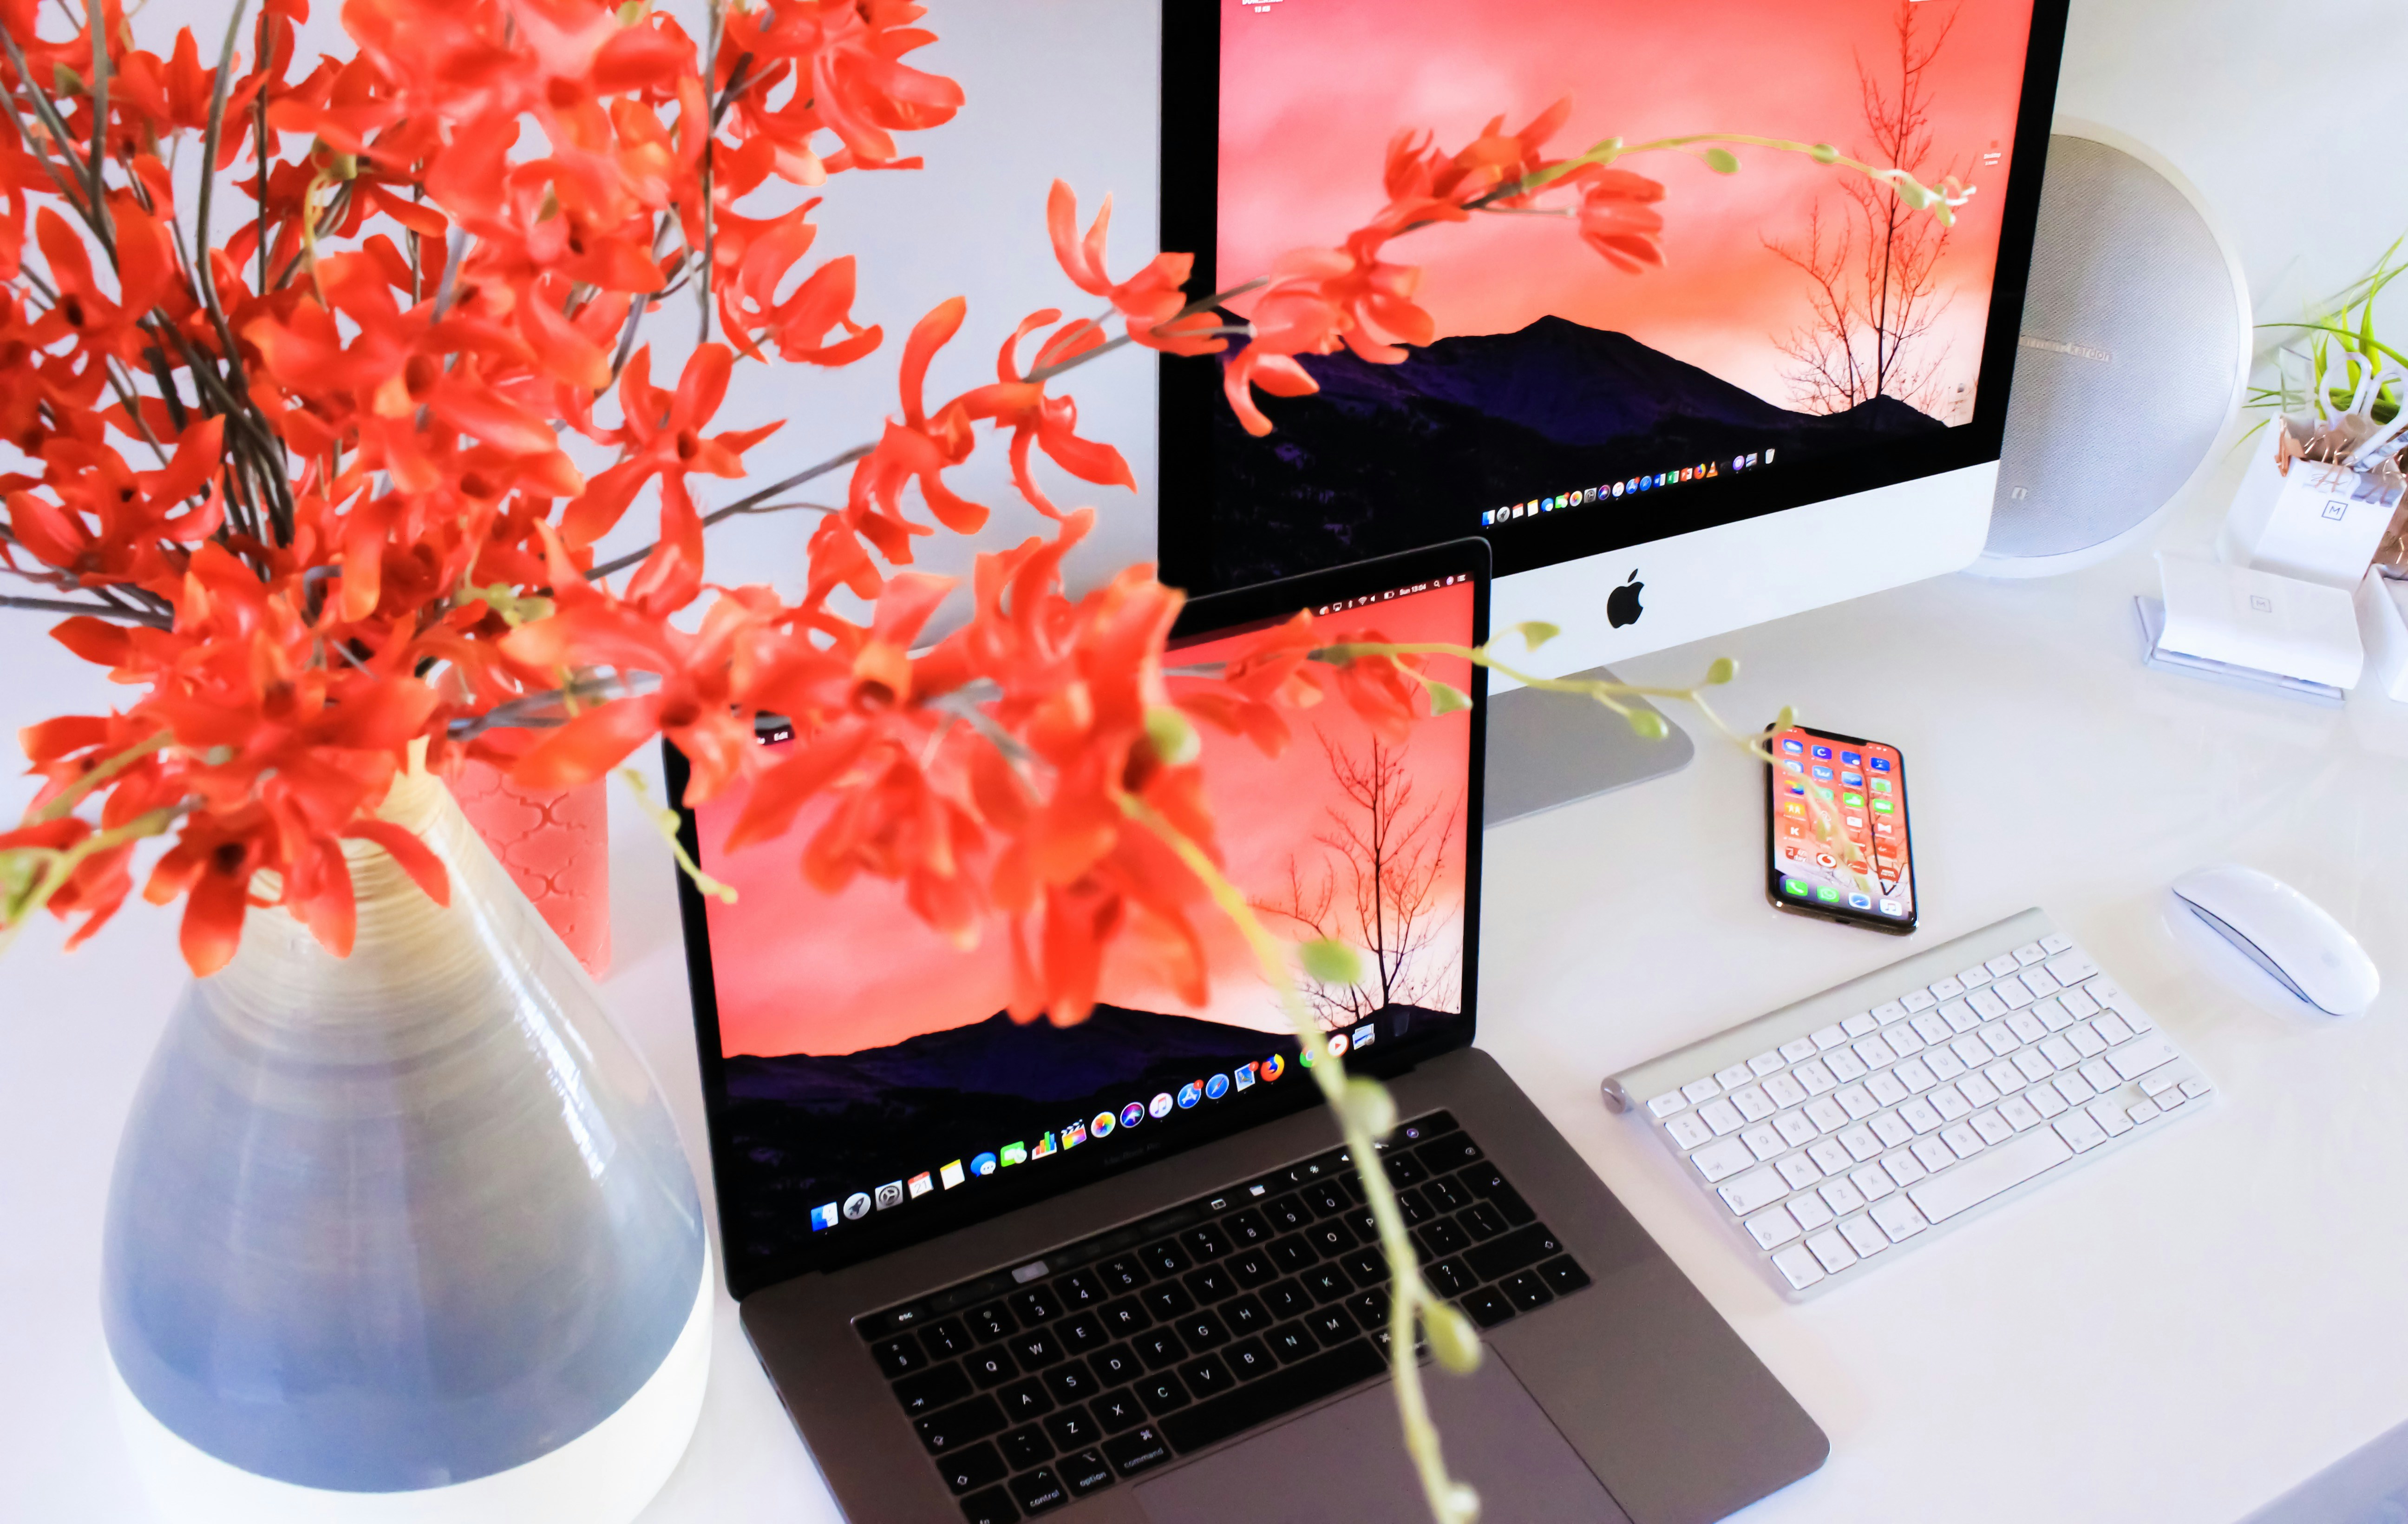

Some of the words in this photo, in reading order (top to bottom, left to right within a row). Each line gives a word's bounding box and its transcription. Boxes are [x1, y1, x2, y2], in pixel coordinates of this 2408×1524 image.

[2329, 506, 2340, 515] M
[914, 1180, 927, 1194] 21
[1327, 1233, 1337, 1242] O
[1246, 1263, 1256, 1273] U
[1362, 1263, 1372, 1272] L
[1205, 1278, 1213, 1288] Y
[1322, 1277, 1332, 1287] K
[1163, 1294, 1171, 1304] T
[1285, 1293, 1291, 1302] J
[1119, 1312, 1130, 1321] R
[1240, 1308, 1251, 1320] H
[1326, 1319, 1339, 1330] M
[1076, 1327, 1086, 1338] E
[1198, 1326, 1208, 1335] G
[1286, 1335, 1297, 1346] N
[1029, 1342, 1042, 1355] W
[1155, 1342, 1163, 1353] F
[1244, 1353, 1254, 1363] B
[986, 1361, 997, 1371] Q
[1110, 1360, 1121, 1370] D
[1200, 1369, 1210, 1379] V
[1066, 1376, 1076, 1386] S
[1158, 1387, 1168, 1397] C
[1022, 1394, 1031, 1405] A
[1112, 1404, 1123, 1416] X
[1067, 1422, 1078, 1433] Z
[1124, 1447, 1164, 1469] command
[1080, 1471, 1106, 1486] option
[1029, 1489, 1060, 1507] control
